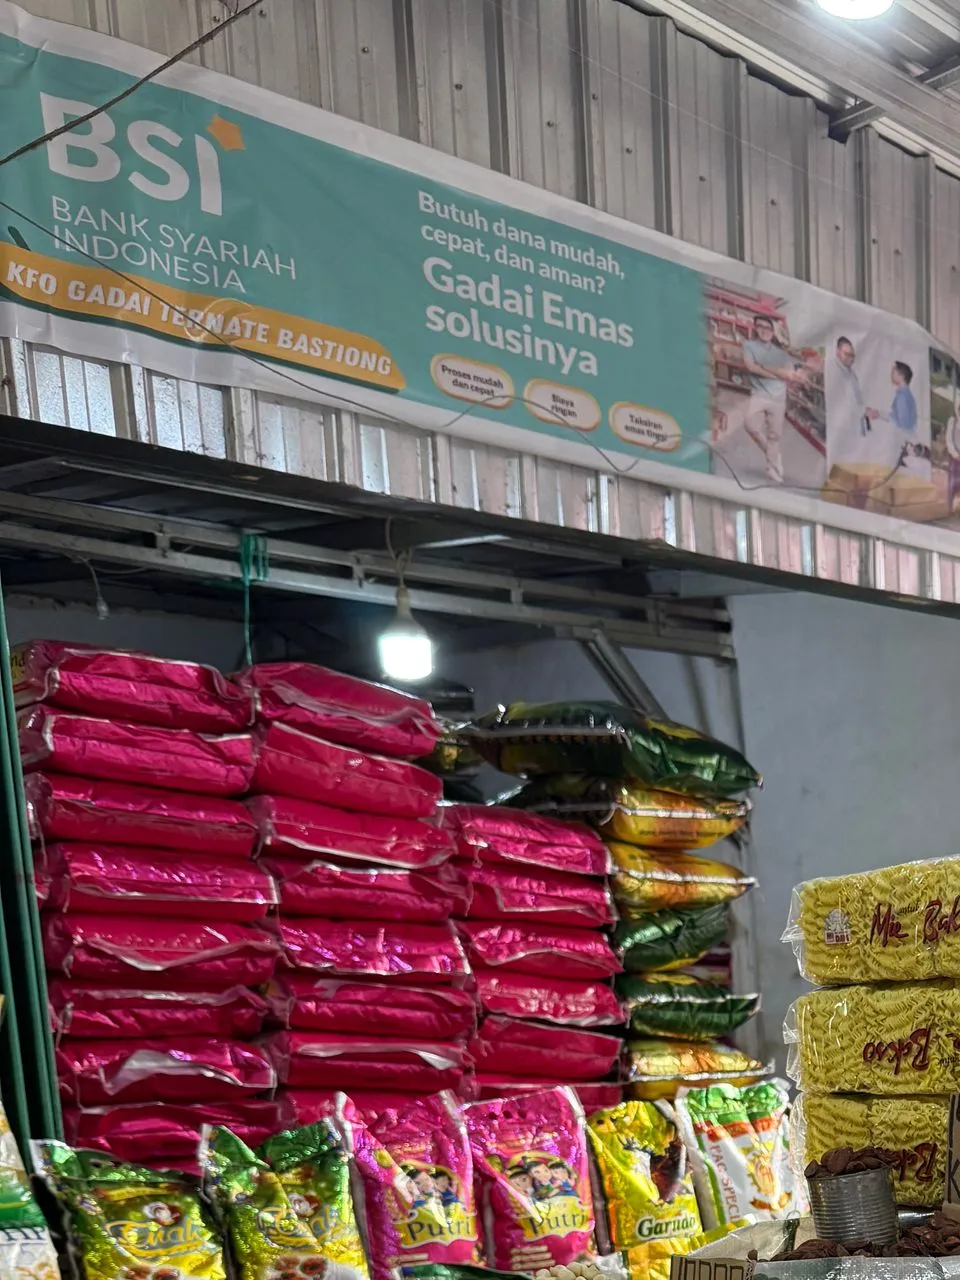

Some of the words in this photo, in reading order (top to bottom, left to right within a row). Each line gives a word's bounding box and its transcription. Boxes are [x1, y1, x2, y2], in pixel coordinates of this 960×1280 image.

[39, 91, 245, 216] BSI
[52, 195, 152, 241] BANK
[158, 224, 296, 280] SYARIAH
[52, 224, 245, 293] INDONESIA
[419, 191, 488, 232] Butuh
[493, 219, 546, 250] dana
[550, 240, 624, 279] mudah,
[421, 224, 490, 261] cepat,
[494, 248, 535, 273] dan
[539, 266, 606, 294] aman?
[7, 261, 57, 295] KFO
[67, 280, 151, 315] GADAI
[160, 300, 269, 343] TERNATE
[277, 332, 392, 375] BASTIONG
[423, 257, 534, 317] Gadai
[543, 291, 634, 347] Emas
[426, 306, 598, 376] solusinya
[442, 365, 471, 379] Proses
[473, 373, 503, 389] mudah
[452, 379, 469, 390] dan
[471, 385, 494, 397] cepat
[870, 903, 909, 947] Mie
[863, 1025, 932, 1075] Bakso
[407, 1217, 470, 1240] Putri
[531, 1212, 586, 1237] Putri
